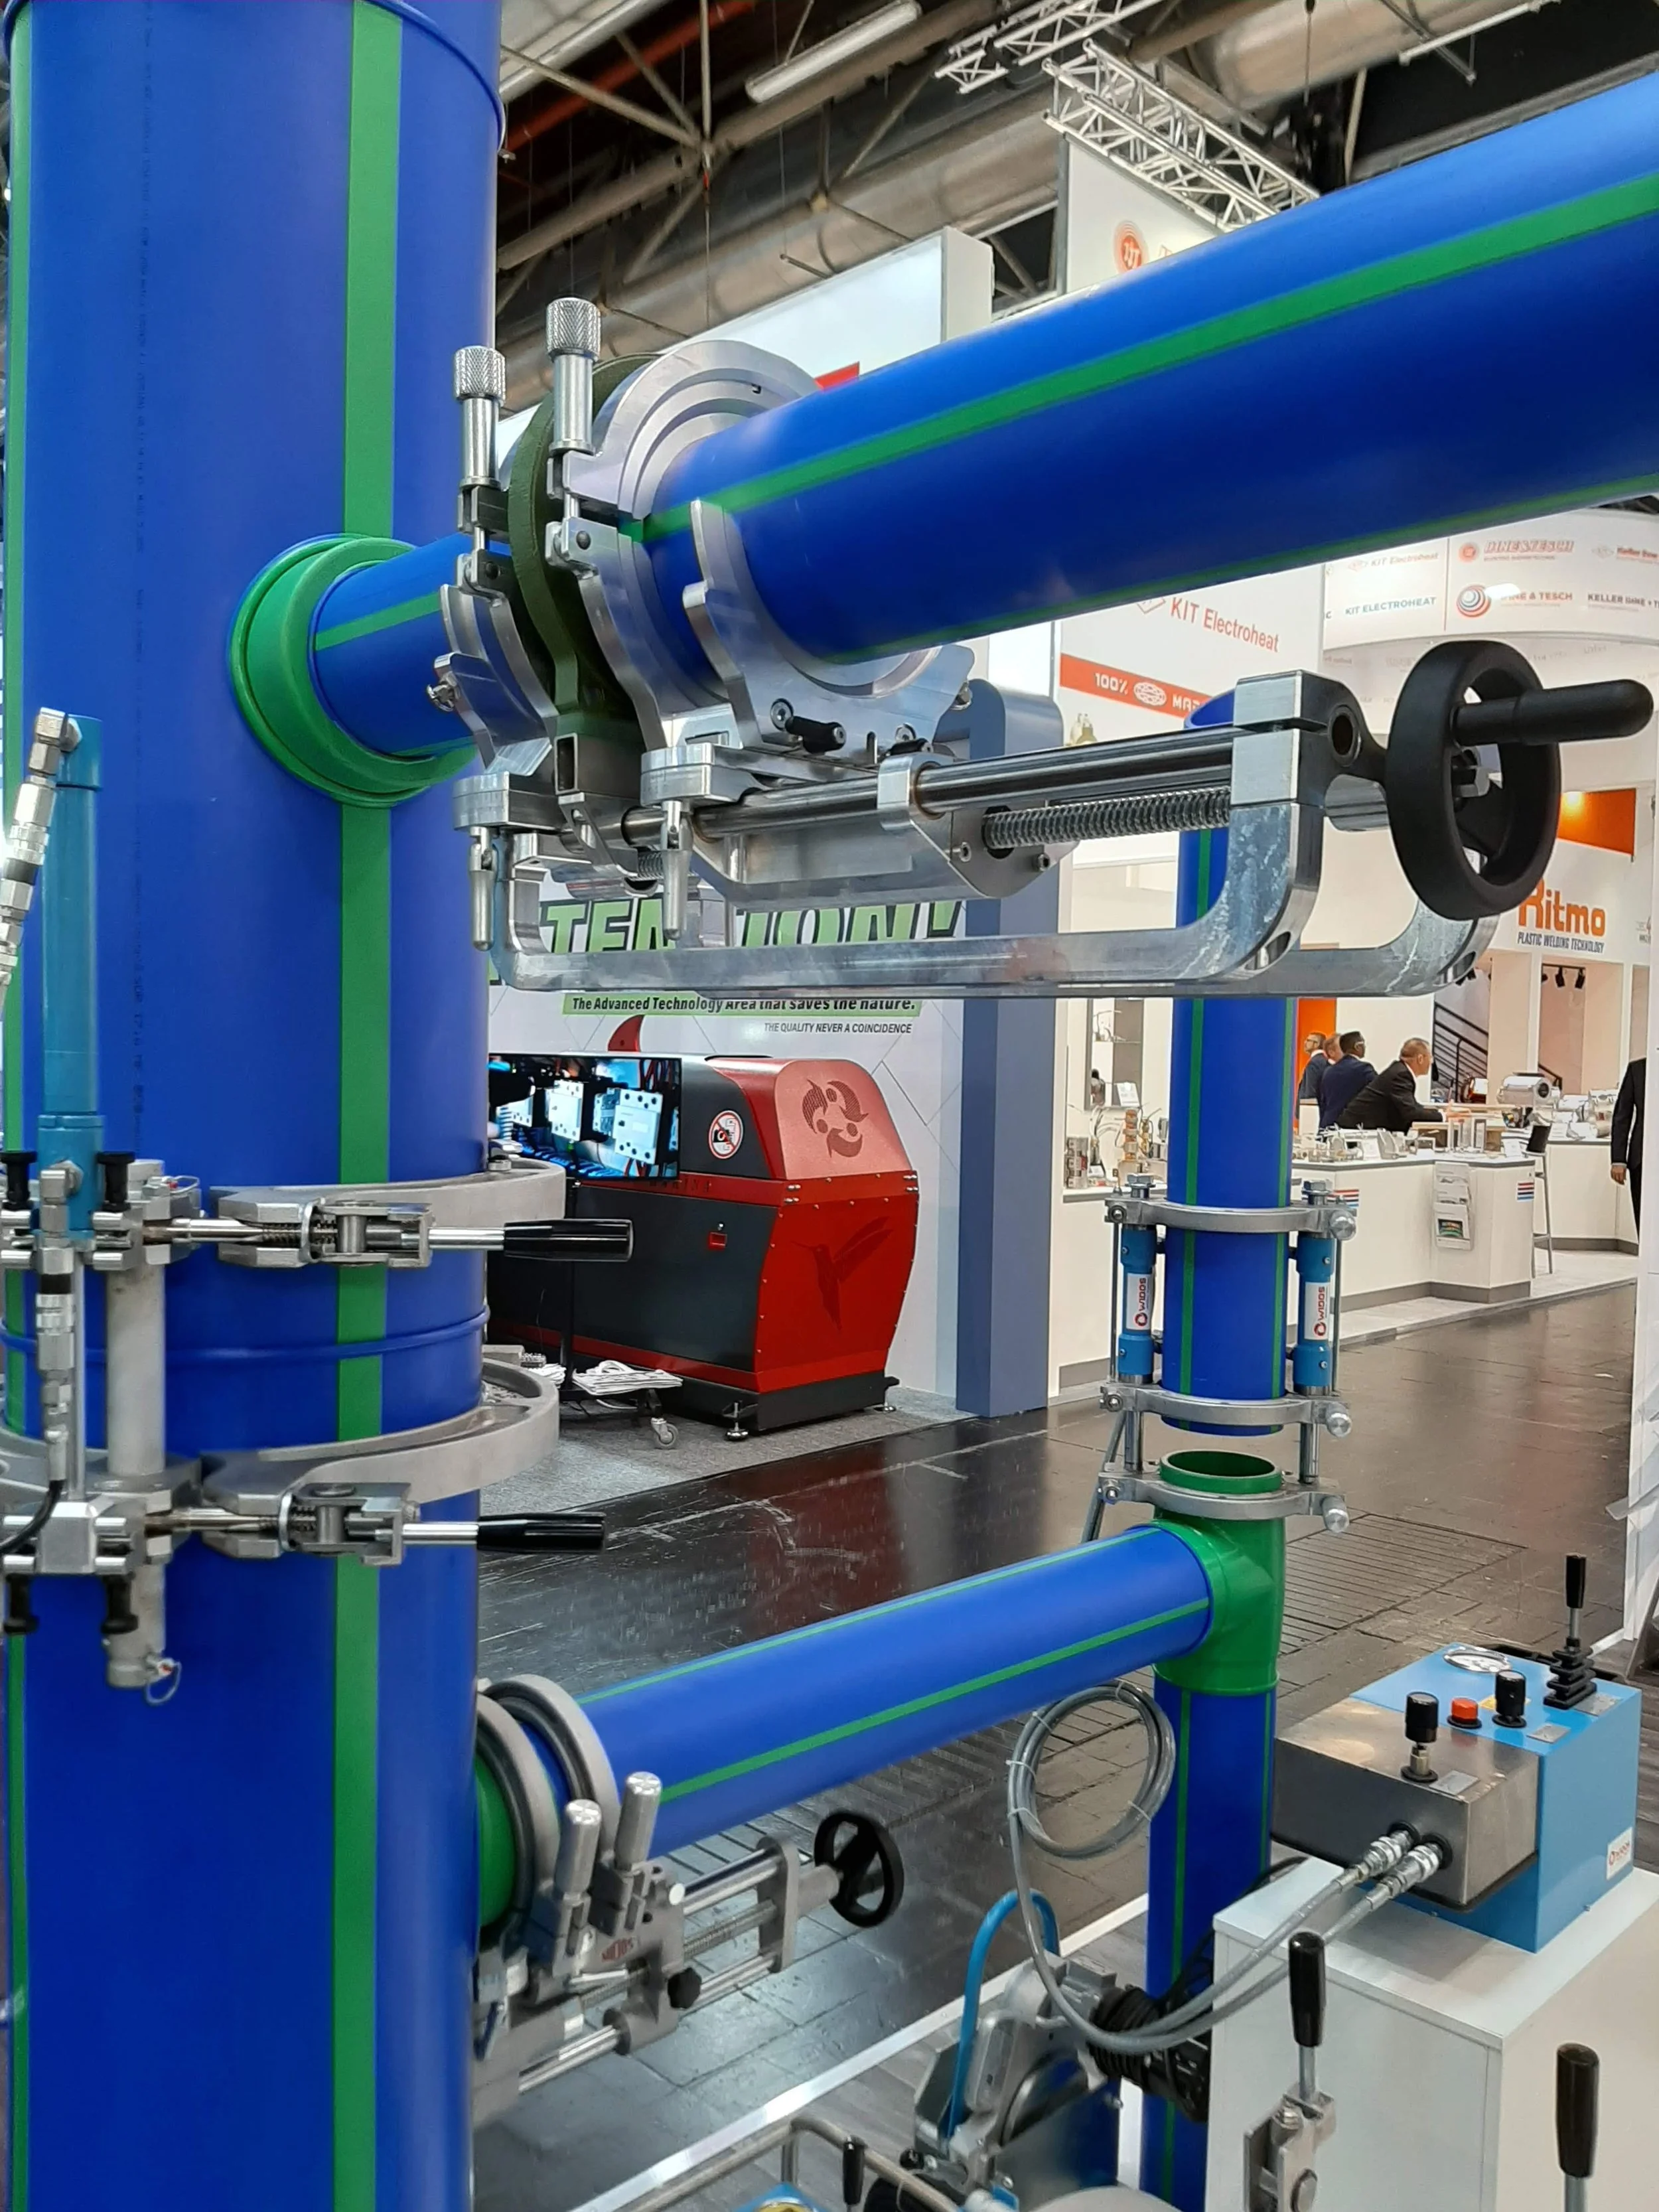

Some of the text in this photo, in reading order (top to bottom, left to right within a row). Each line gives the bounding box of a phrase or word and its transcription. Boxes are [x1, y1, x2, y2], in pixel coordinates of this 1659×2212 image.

[1371, 557, 1388, 567] KIT
[1345, 606, 1360, 615] KIT
[1362, 597, 1437, 613] ELECTROHEAT
[1587, 594, 1623, 603] KELLER
[1170, 597, 1279, 653] KIT Electroheat
[1094, 672, 1128, 696] 100%
[1518, 877, 1606, 937] Ritmo
[1517, 931, 1605, 954] PLASTIC WELDING TECHNOLOGY
[573, 997, 915, 1013] The Advanced Technology Area that saves the nature.
[764, 1023, 912, 1033] THE QUALITY NEVER A COINCIDENCE
[1138, 1277, 1147, 1312] WIDOS
